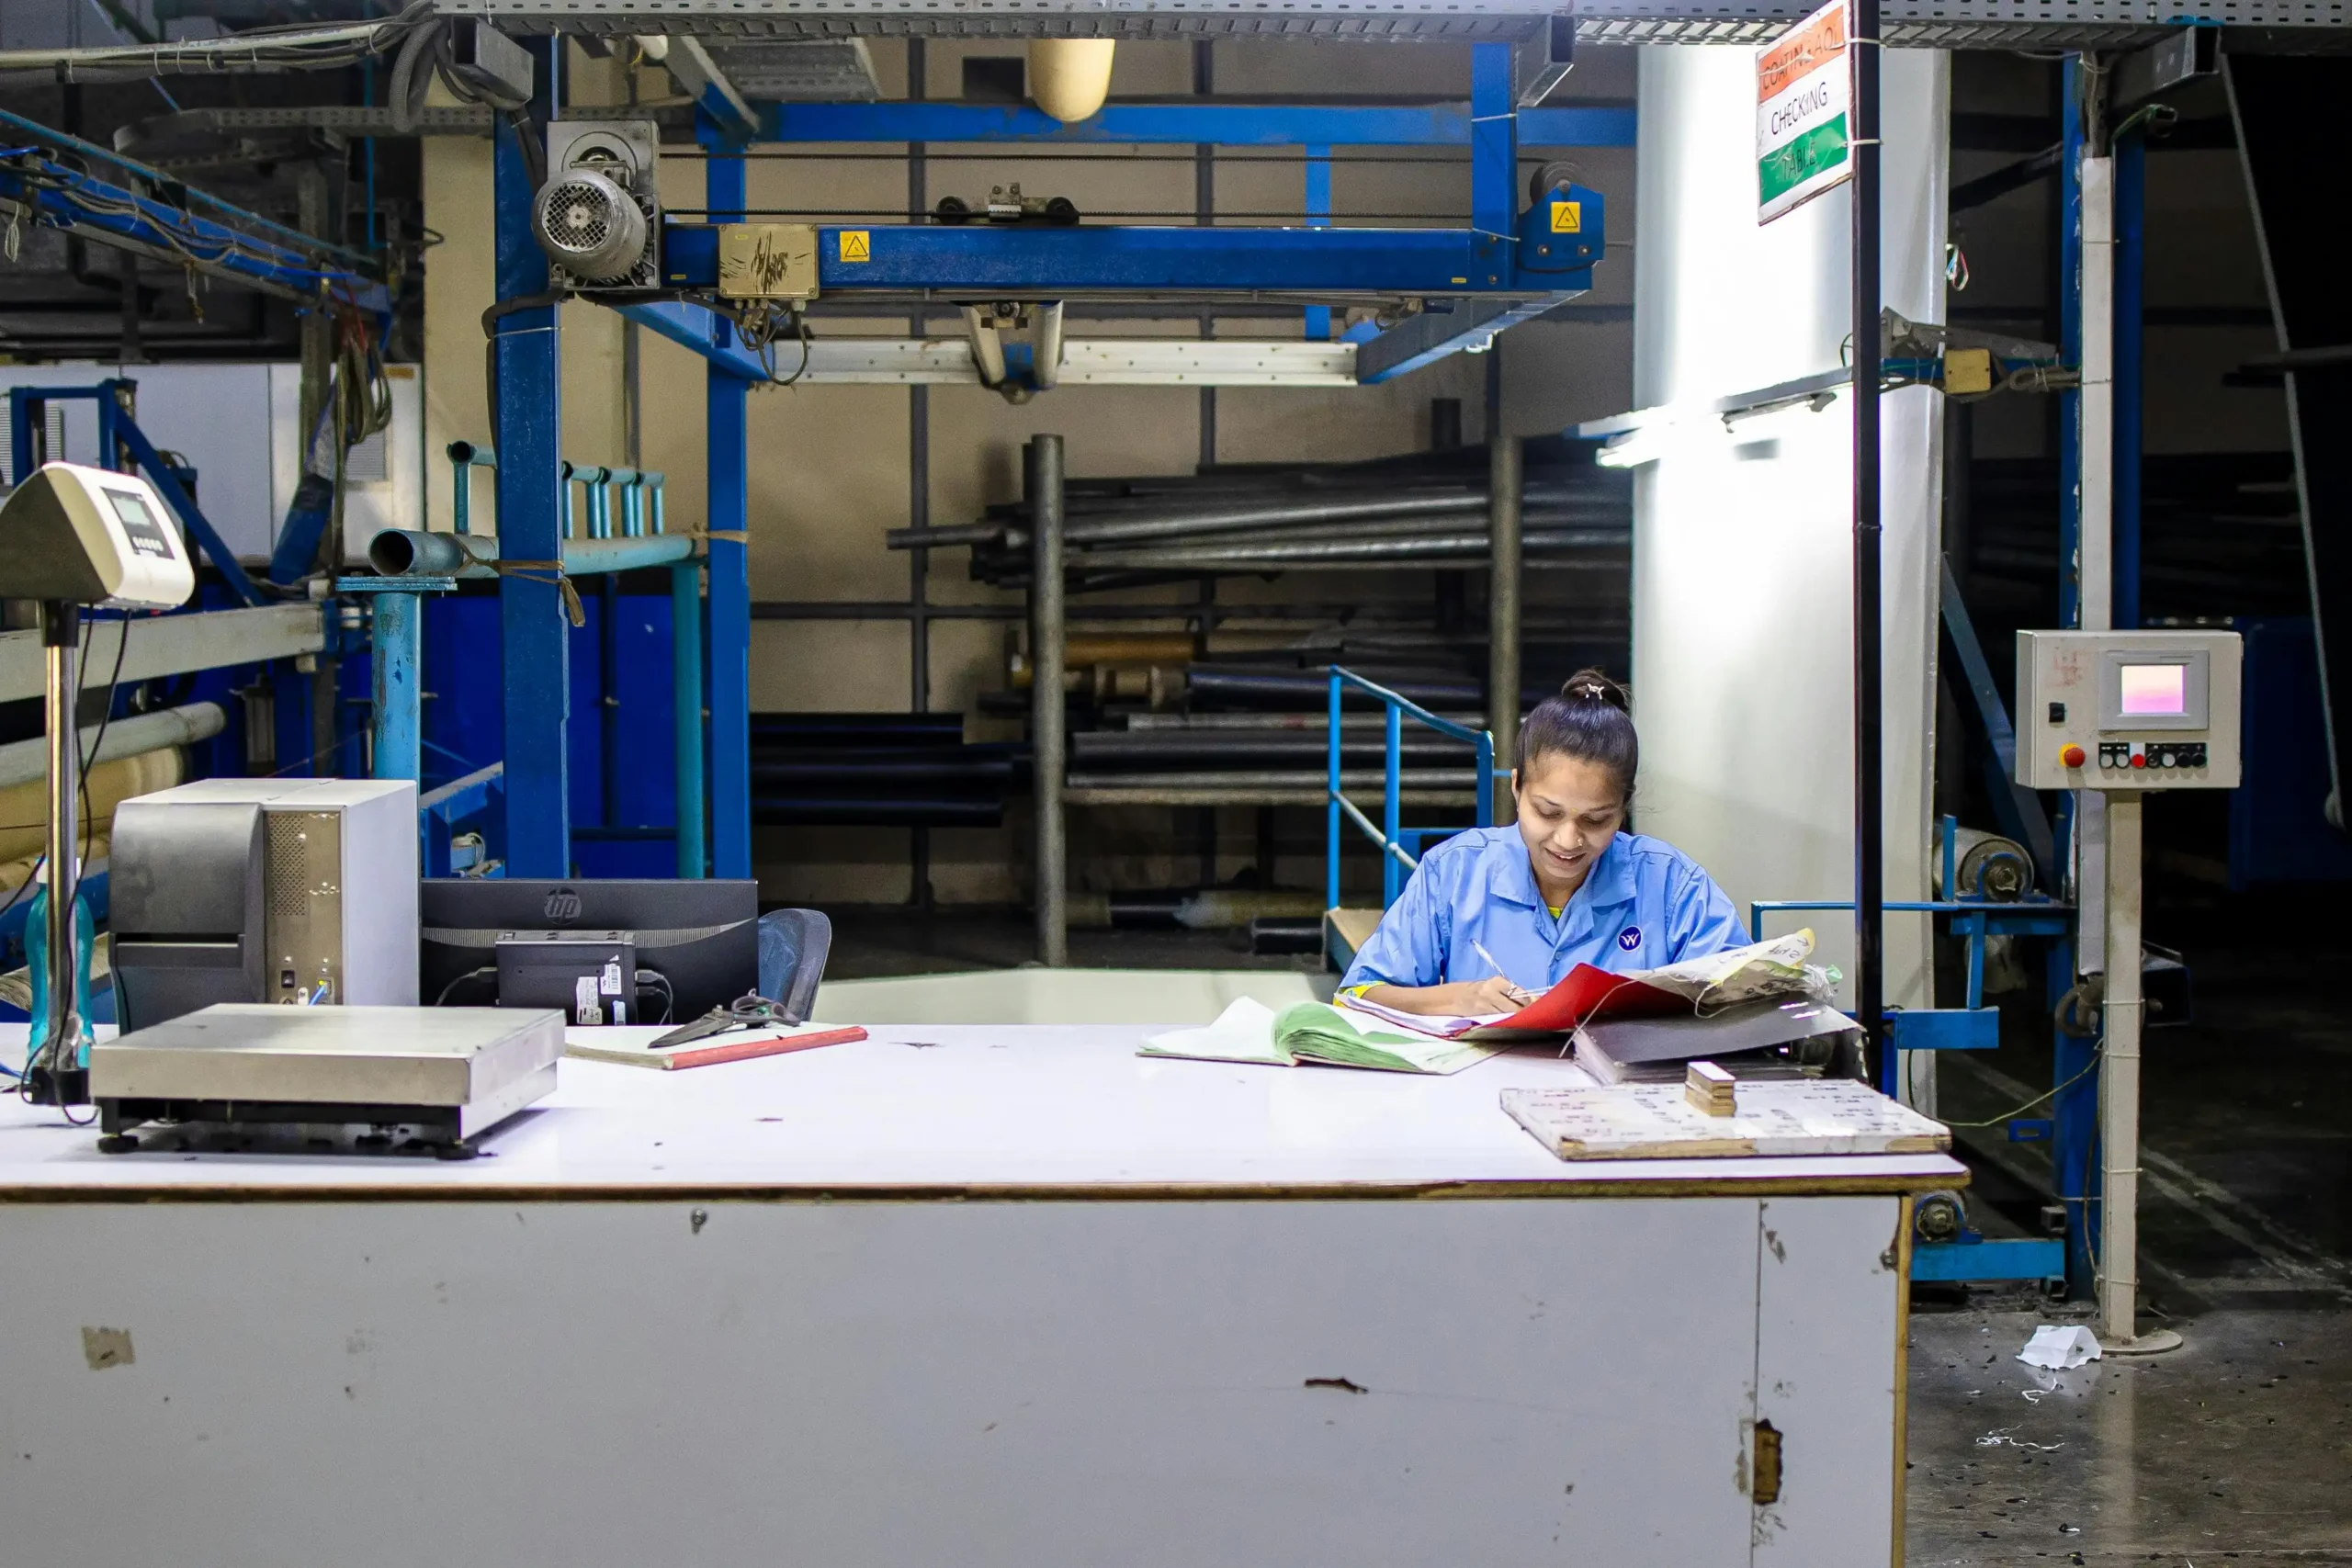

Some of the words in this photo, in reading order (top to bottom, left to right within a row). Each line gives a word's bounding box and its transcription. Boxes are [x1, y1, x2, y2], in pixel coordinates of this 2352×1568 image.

[1770, 81, 1828, 136] CHECKING
[1781, 140, 1816, 179] TABLE
[544, 887, 582, 925] hp
